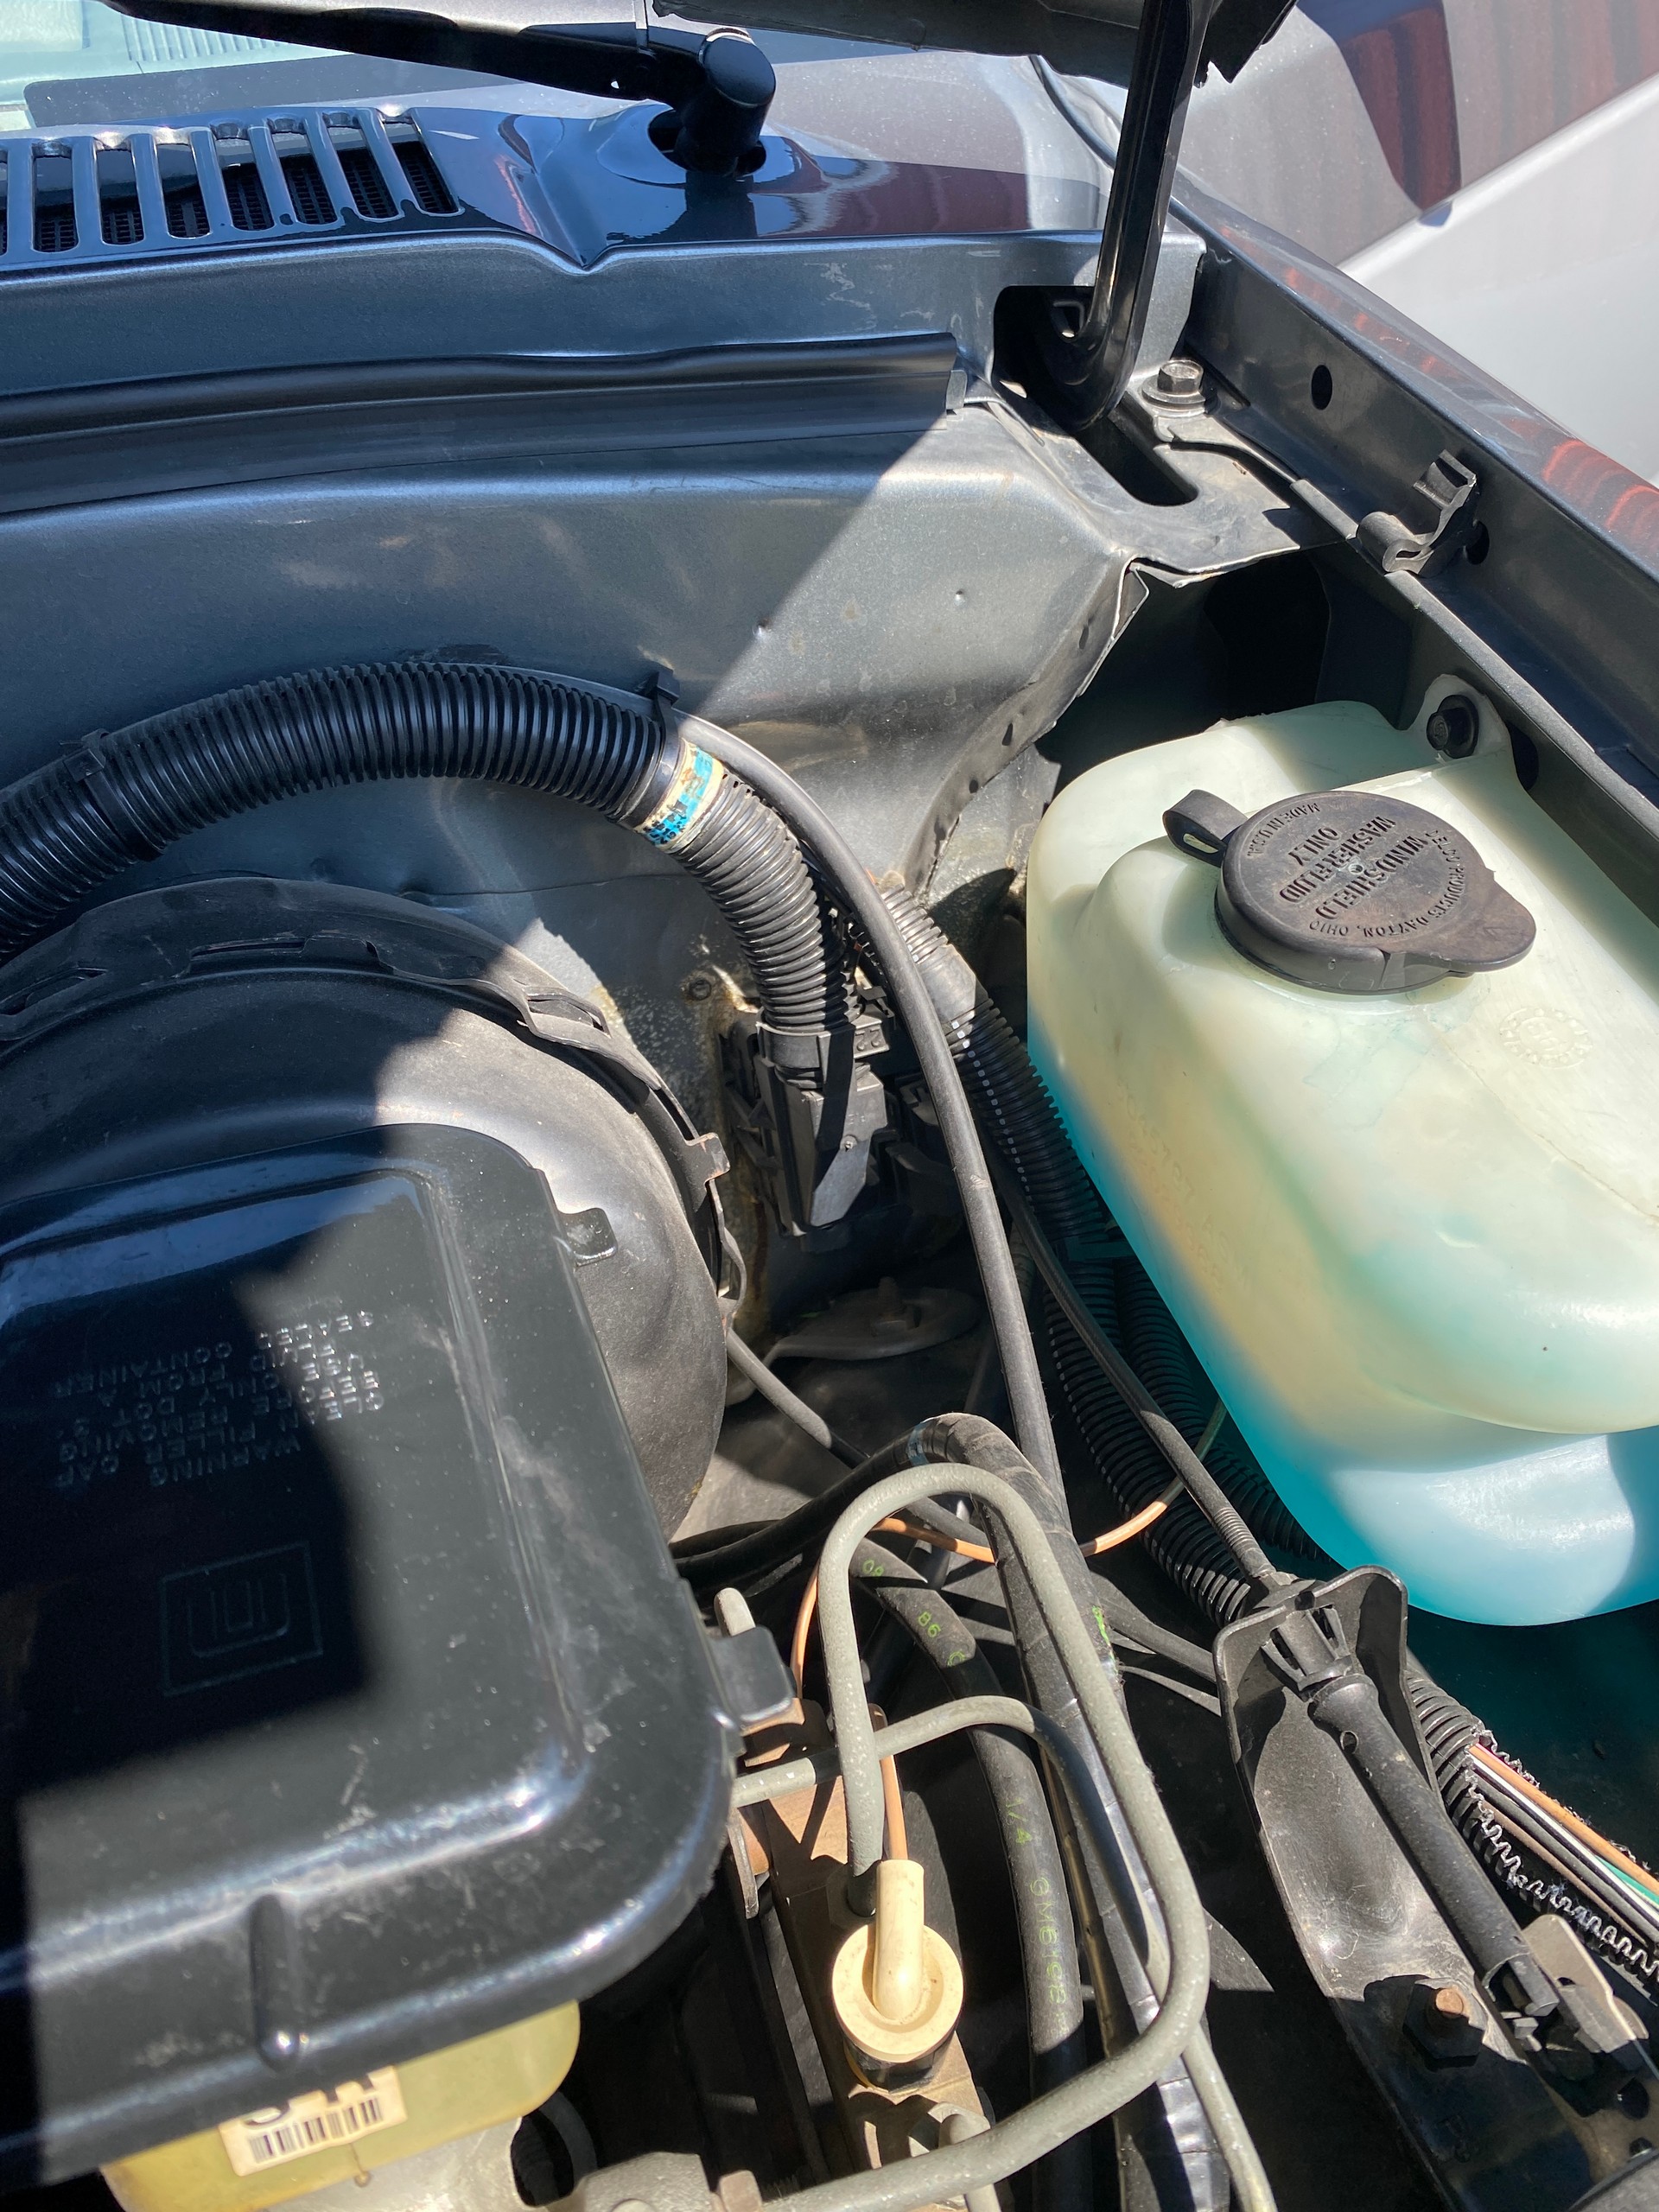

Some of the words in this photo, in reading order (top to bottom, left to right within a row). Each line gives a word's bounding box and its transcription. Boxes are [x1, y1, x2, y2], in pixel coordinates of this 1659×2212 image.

[1268, 816, 1285, 833] IN
[1281, 802, 1320, 823] MADE
[1287, 826, 1338, 867] ONLY
[1328, 816, 1395, 869] WASHER
[1278, 857, 1332, 904] FLUID
[1313, 835, 1427, 920] WINDSHIELD
[1427, 867, 1465, 919] PRODUCTS
[1309, 920, 1348, 937] OHIO
[256, 1309, 375, 1350] SEALED
[50, 1340, 233, 1399] CONTAINER
[249, 1338, 337, 1374] FLUID
[302, 1352, 365, 1382] USE
[97, 1388, 118, 1408] A
[138, 1363, 226, 1400] FROM
[198, 1372, 280, 1407] ONLY
[251, 1370, 379, 1416] BEFORE
[111, 1395, 175, 1428] DOT
[277, 1390, 384, 1433] CLEAN
[58, 1405, 228, 1464] REMOVING
[143, 1421, 255, 1465] FILLER
[54, 1454, 119, 1489] CAP
[149, 1434, 301, 1487] WARNING
